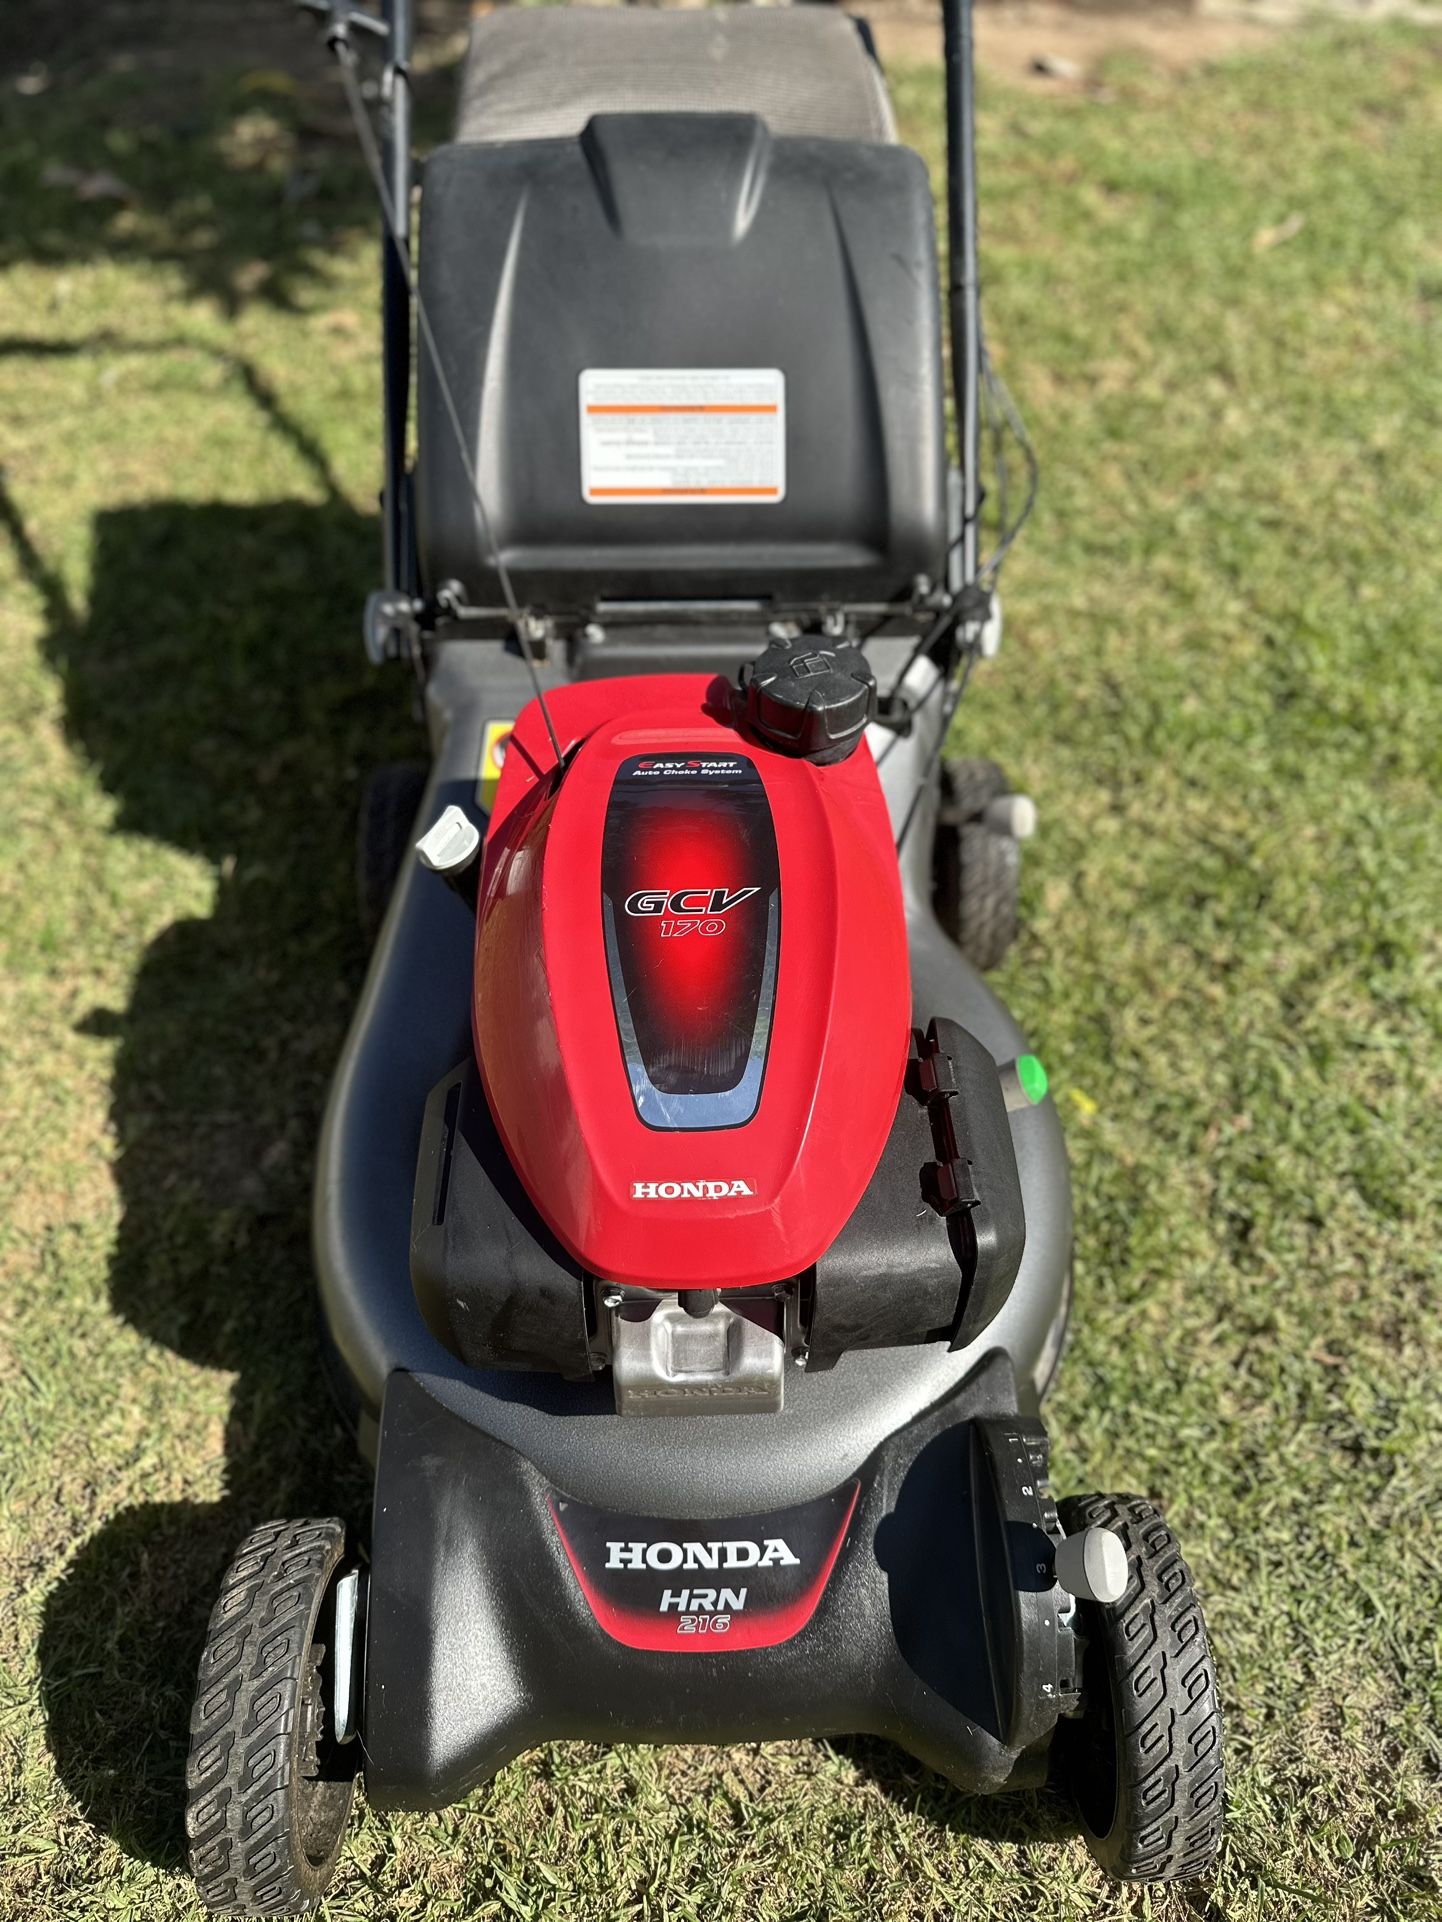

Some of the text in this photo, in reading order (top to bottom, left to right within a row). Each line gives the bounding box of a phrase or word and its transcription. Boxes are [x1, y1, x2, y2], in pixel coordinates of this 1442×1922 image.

[638, 760, 738, 769] EASY START
[624, 886, 762, 917] GCV
[659, 918, 726, 938] 170
[632, 1180, 754, 1200] HONDA
[627, 1386, 769, 1399] HONDA
[1021, 1485, 1034, 1496] 2
[604, 1538, 800, 1570] HONDA
[1036, 1562, 1047, 1574] 3
[659, 1587, 747, 1613] HRN
[676, 1614, 731, 1634] 216
[1042, 1683, 1053, 1693] 4
